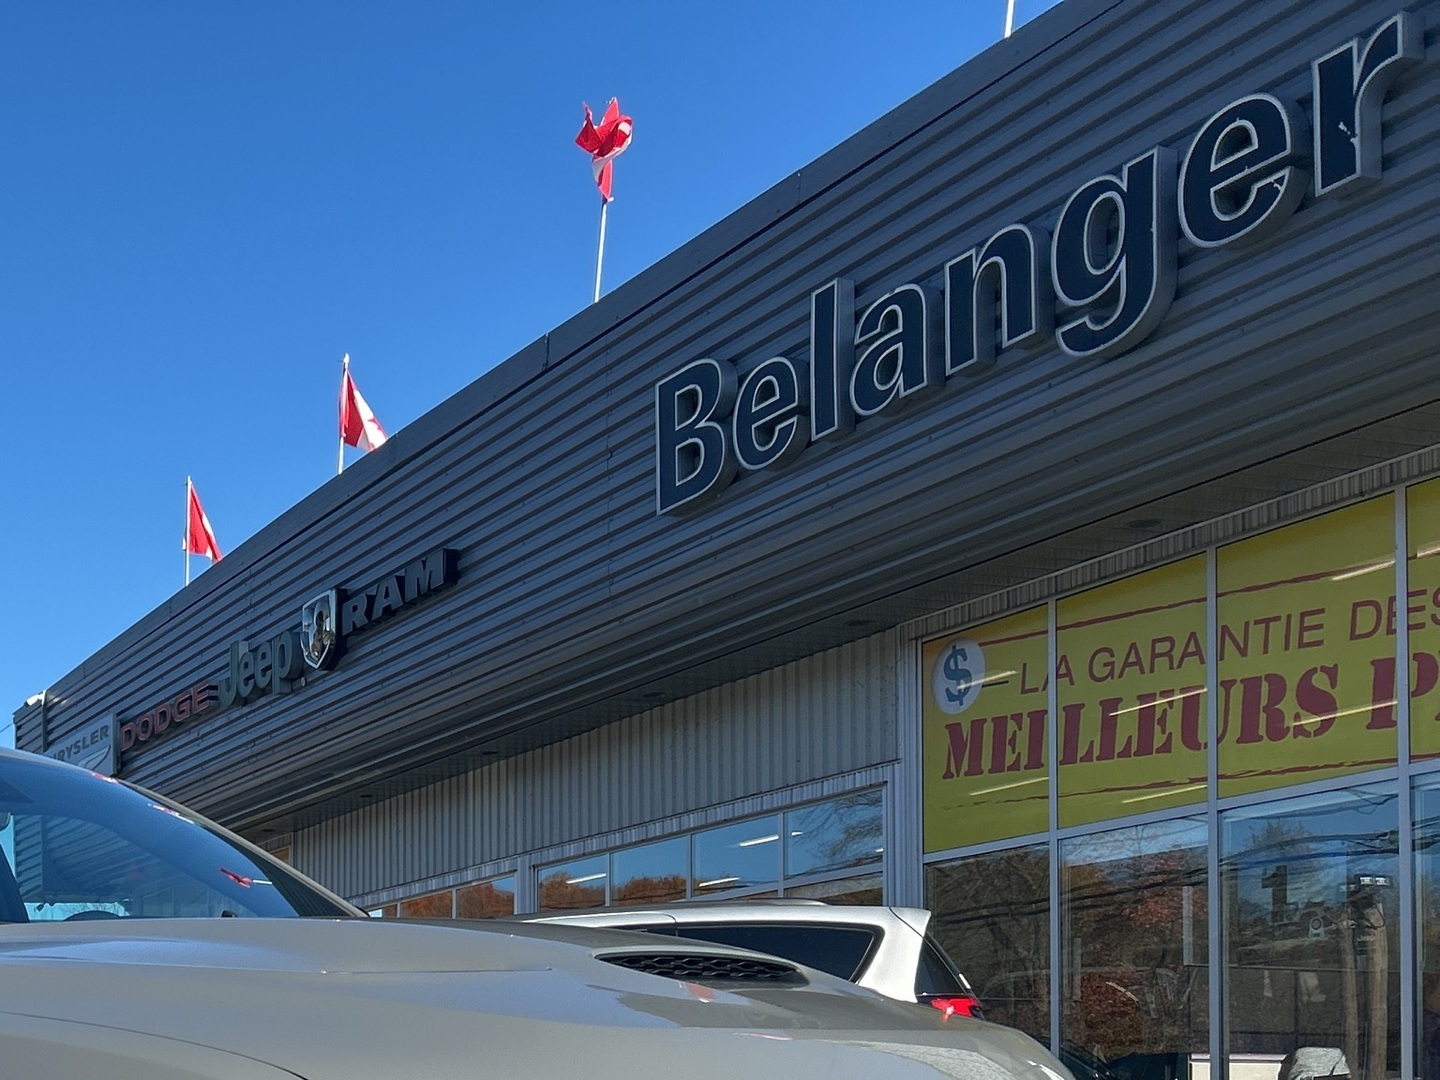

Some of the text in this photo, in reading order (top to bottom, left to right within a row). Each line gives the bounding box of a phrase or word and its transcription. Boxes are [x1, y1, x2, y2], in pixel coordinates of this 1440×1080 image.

[655, 12, 1418, 517] Belanger
[53, 549, 452, 761] RYSLER DODGE Jeep RAM
[942, 663, 1338, 780] MEILLEURS
[1020, 587, 1440, 695] LA GARANTIE DE
